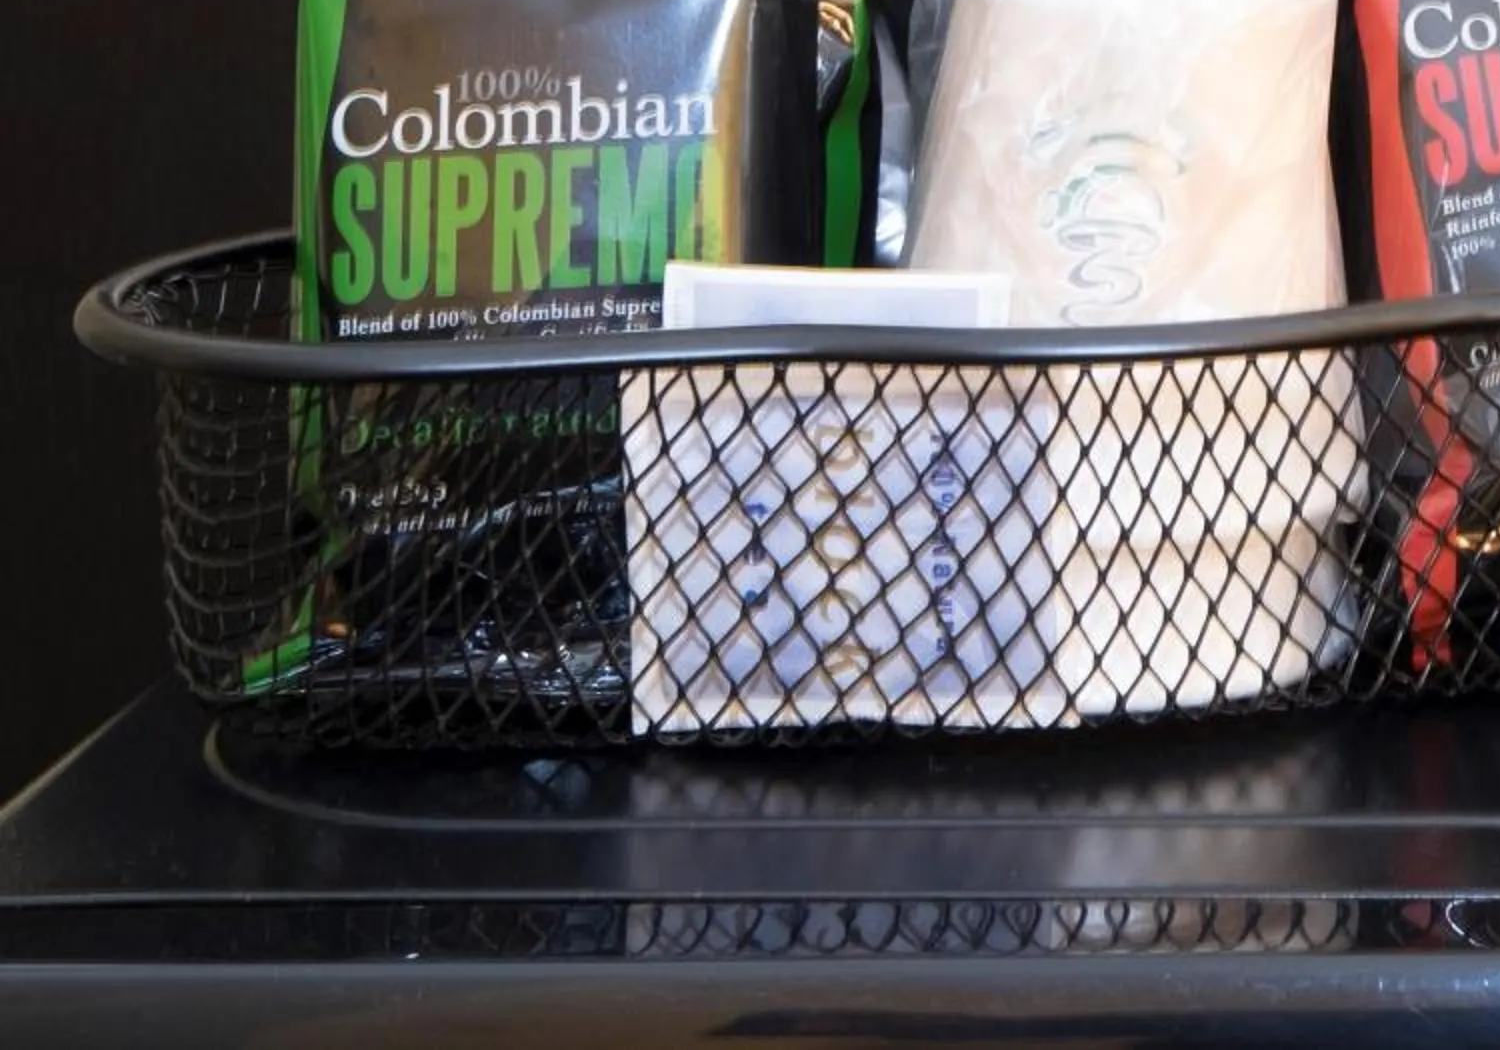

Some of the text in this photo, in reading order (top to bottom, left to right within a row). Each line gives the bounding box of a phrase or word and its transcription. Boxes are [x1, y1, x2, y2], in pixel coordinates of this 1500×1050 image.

[456, 66, 561, 103] 100%
[331, 75, 718, 159] Colombian
[1442, 186, 1494, 216] Blend
[1449, 235, 1496, 261] 100%
[338, 298, 661, 337] Blend of 100% Colombian Supre
